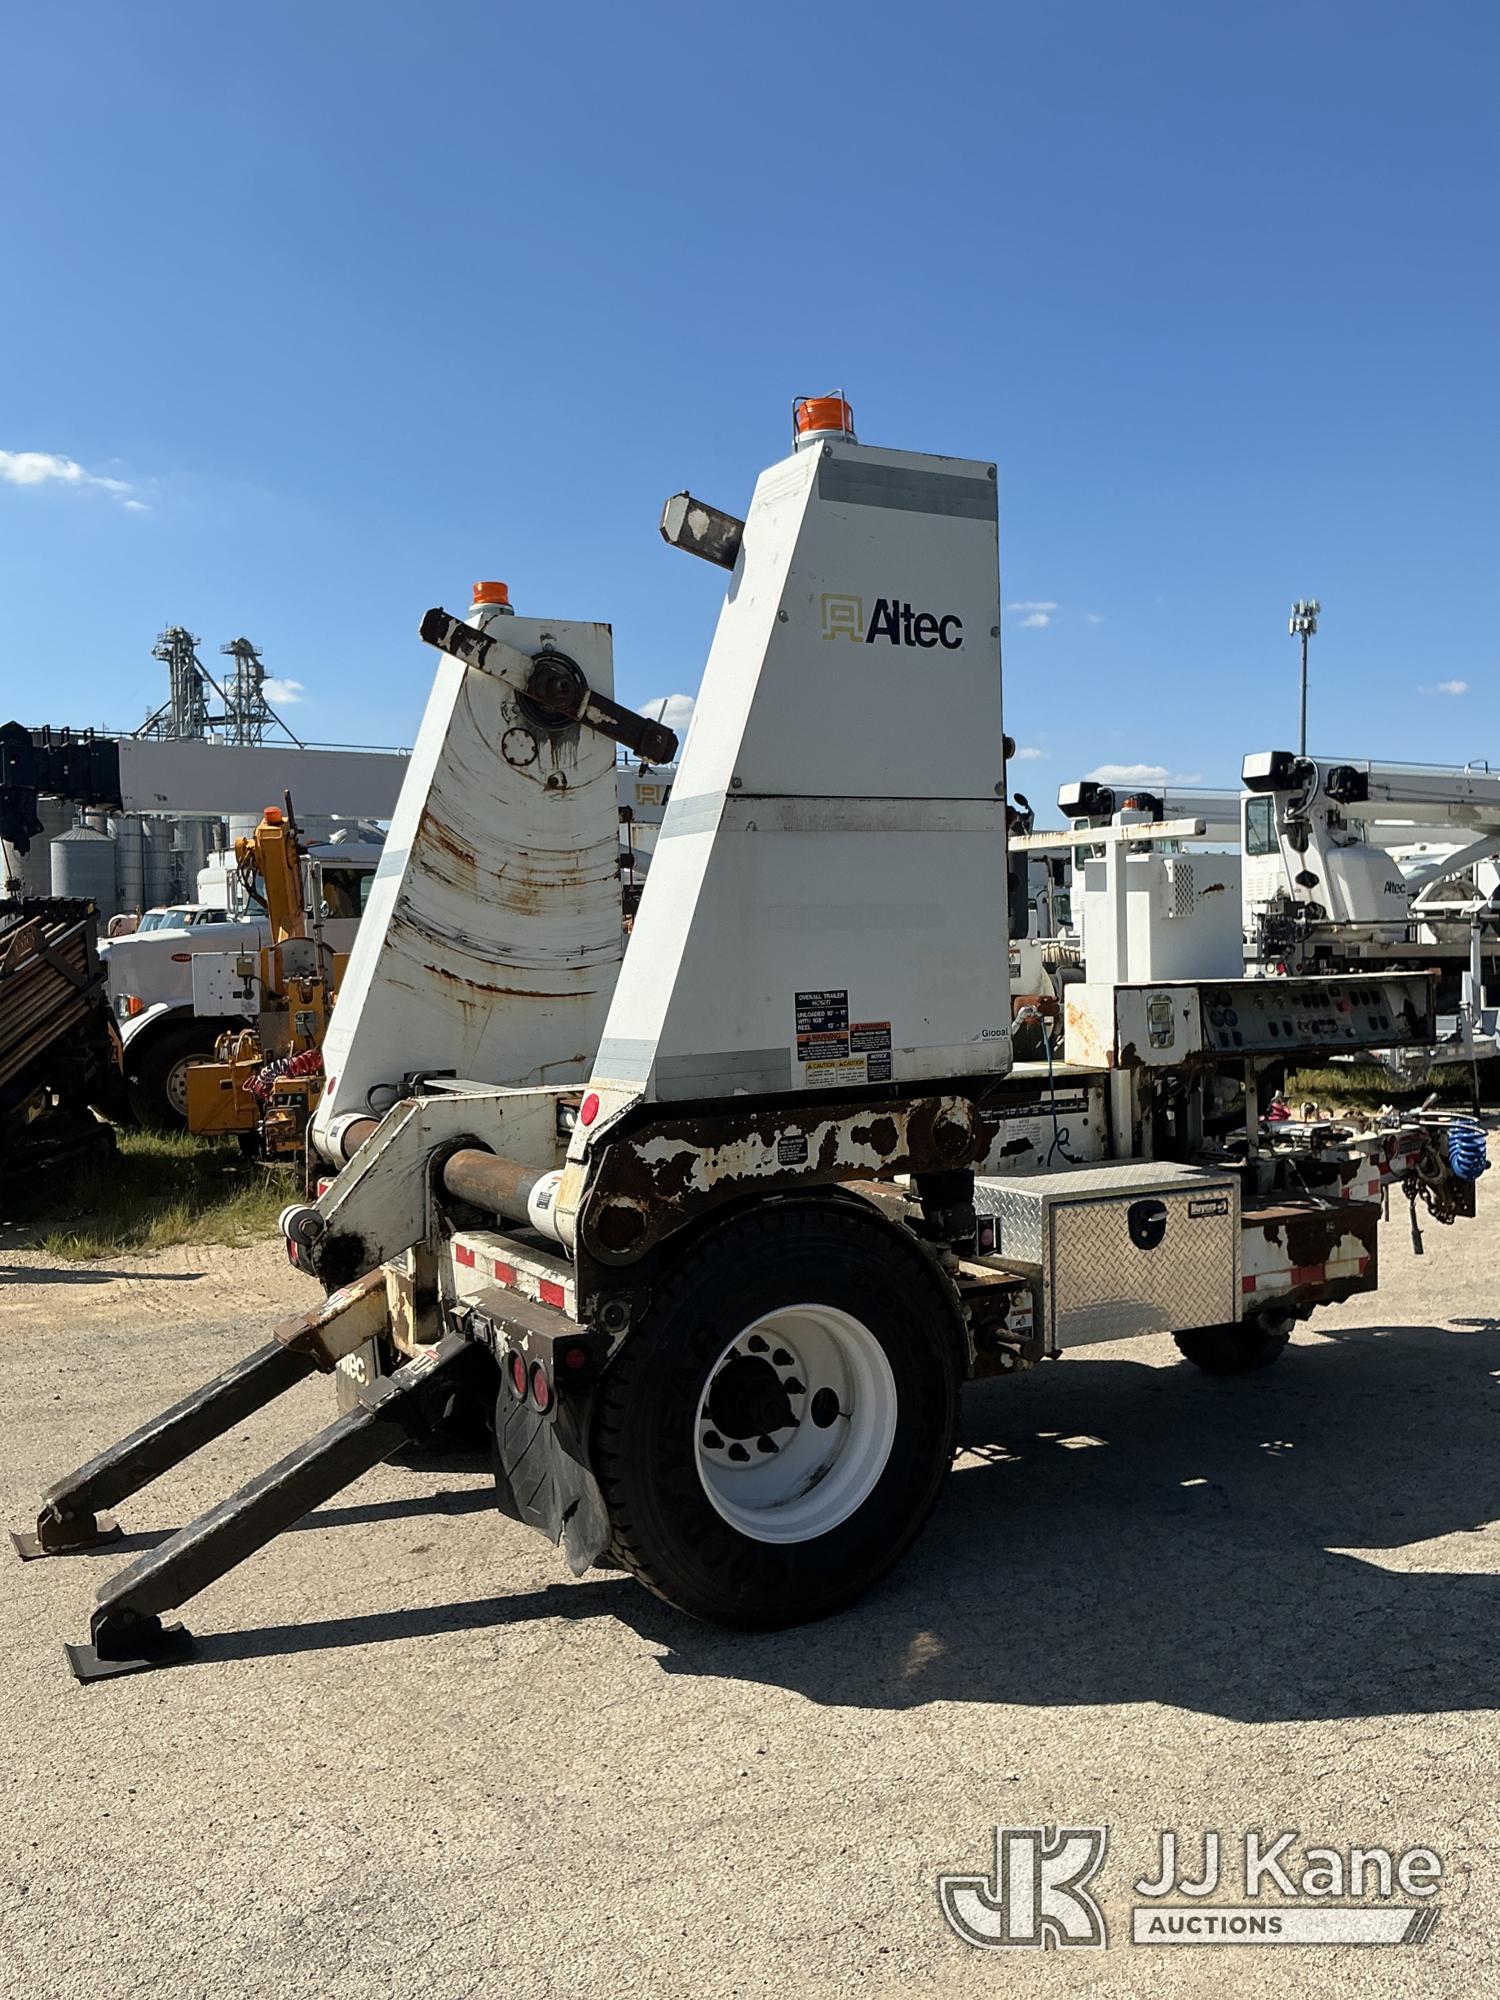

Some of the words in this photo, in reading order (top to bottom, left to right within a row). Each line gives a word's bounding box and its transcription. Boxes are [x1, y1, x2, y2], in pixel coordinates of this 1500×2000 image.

[866, 598, 963, 650] Altec
[1384, 880, 1406, 895] Altec
[981, 1027, 1008, 1038] Global
[1190, 1203, 1217, 1213] Buyers
